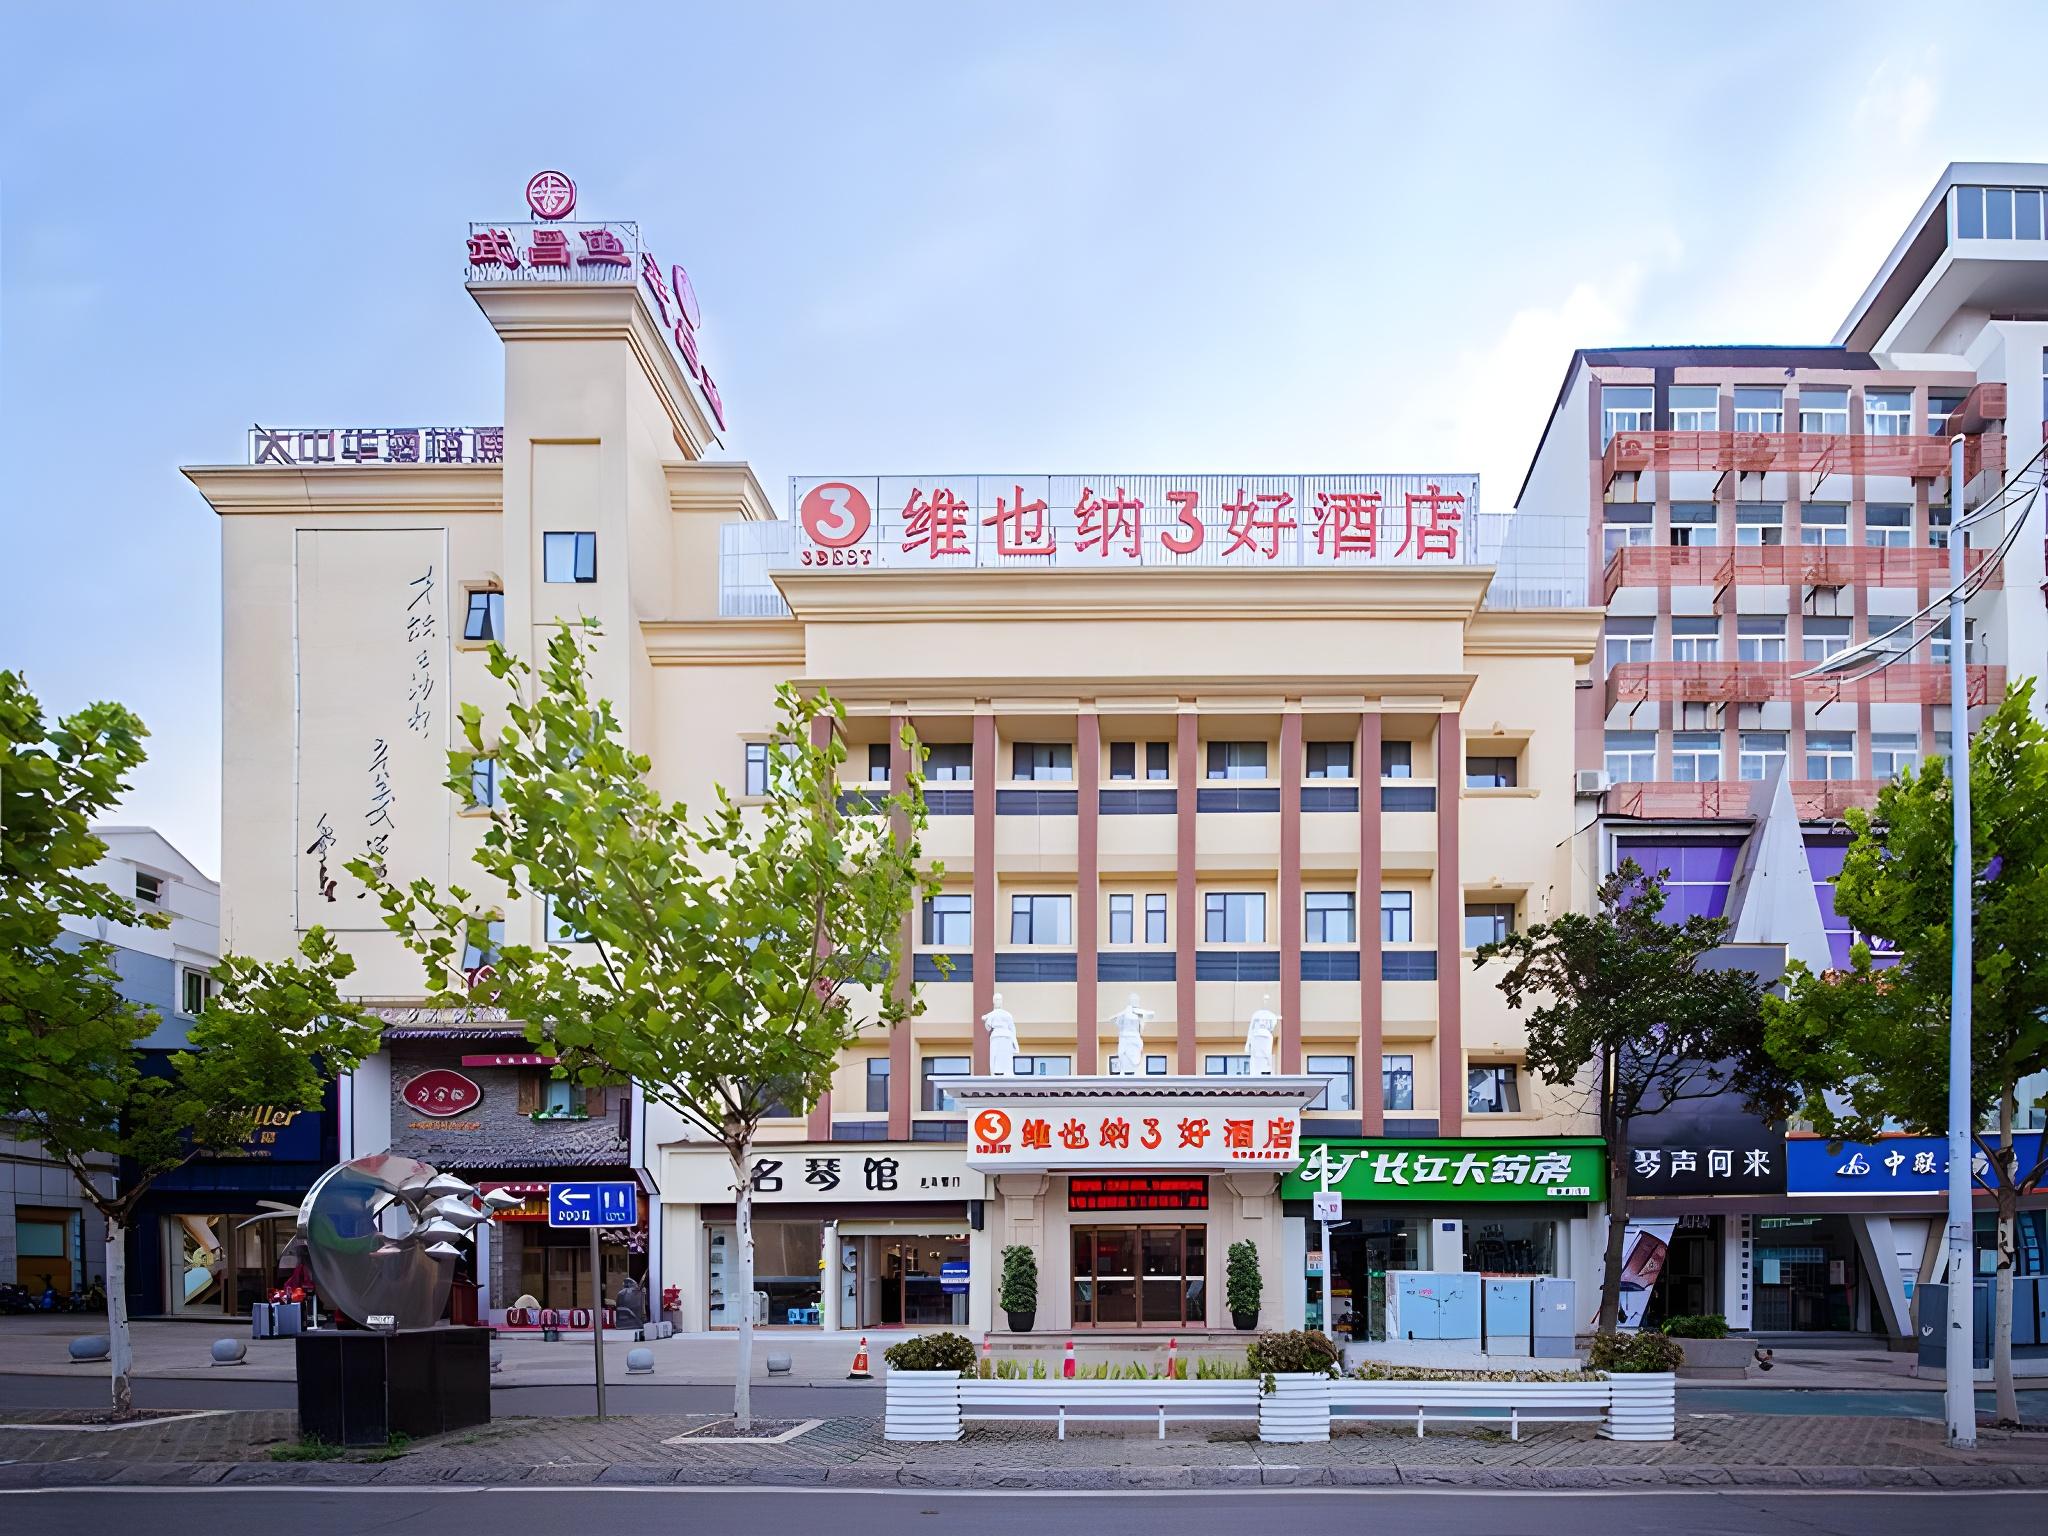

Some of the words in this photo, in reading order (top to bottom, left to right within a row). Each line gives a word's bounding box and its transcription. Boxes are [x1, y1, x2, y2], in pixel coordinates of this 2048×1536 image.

[901, 483, 1467, 561] 维也纳3好酒店
[1020, 1116, 1295, 1150] 维也纳3好酒店
[751, 1156, 900, 1192] 名琴馆
[1369, 1150, 1573, 1186] 长江大药房
[1633, 1148, 1771, 1179] 琴声何来
